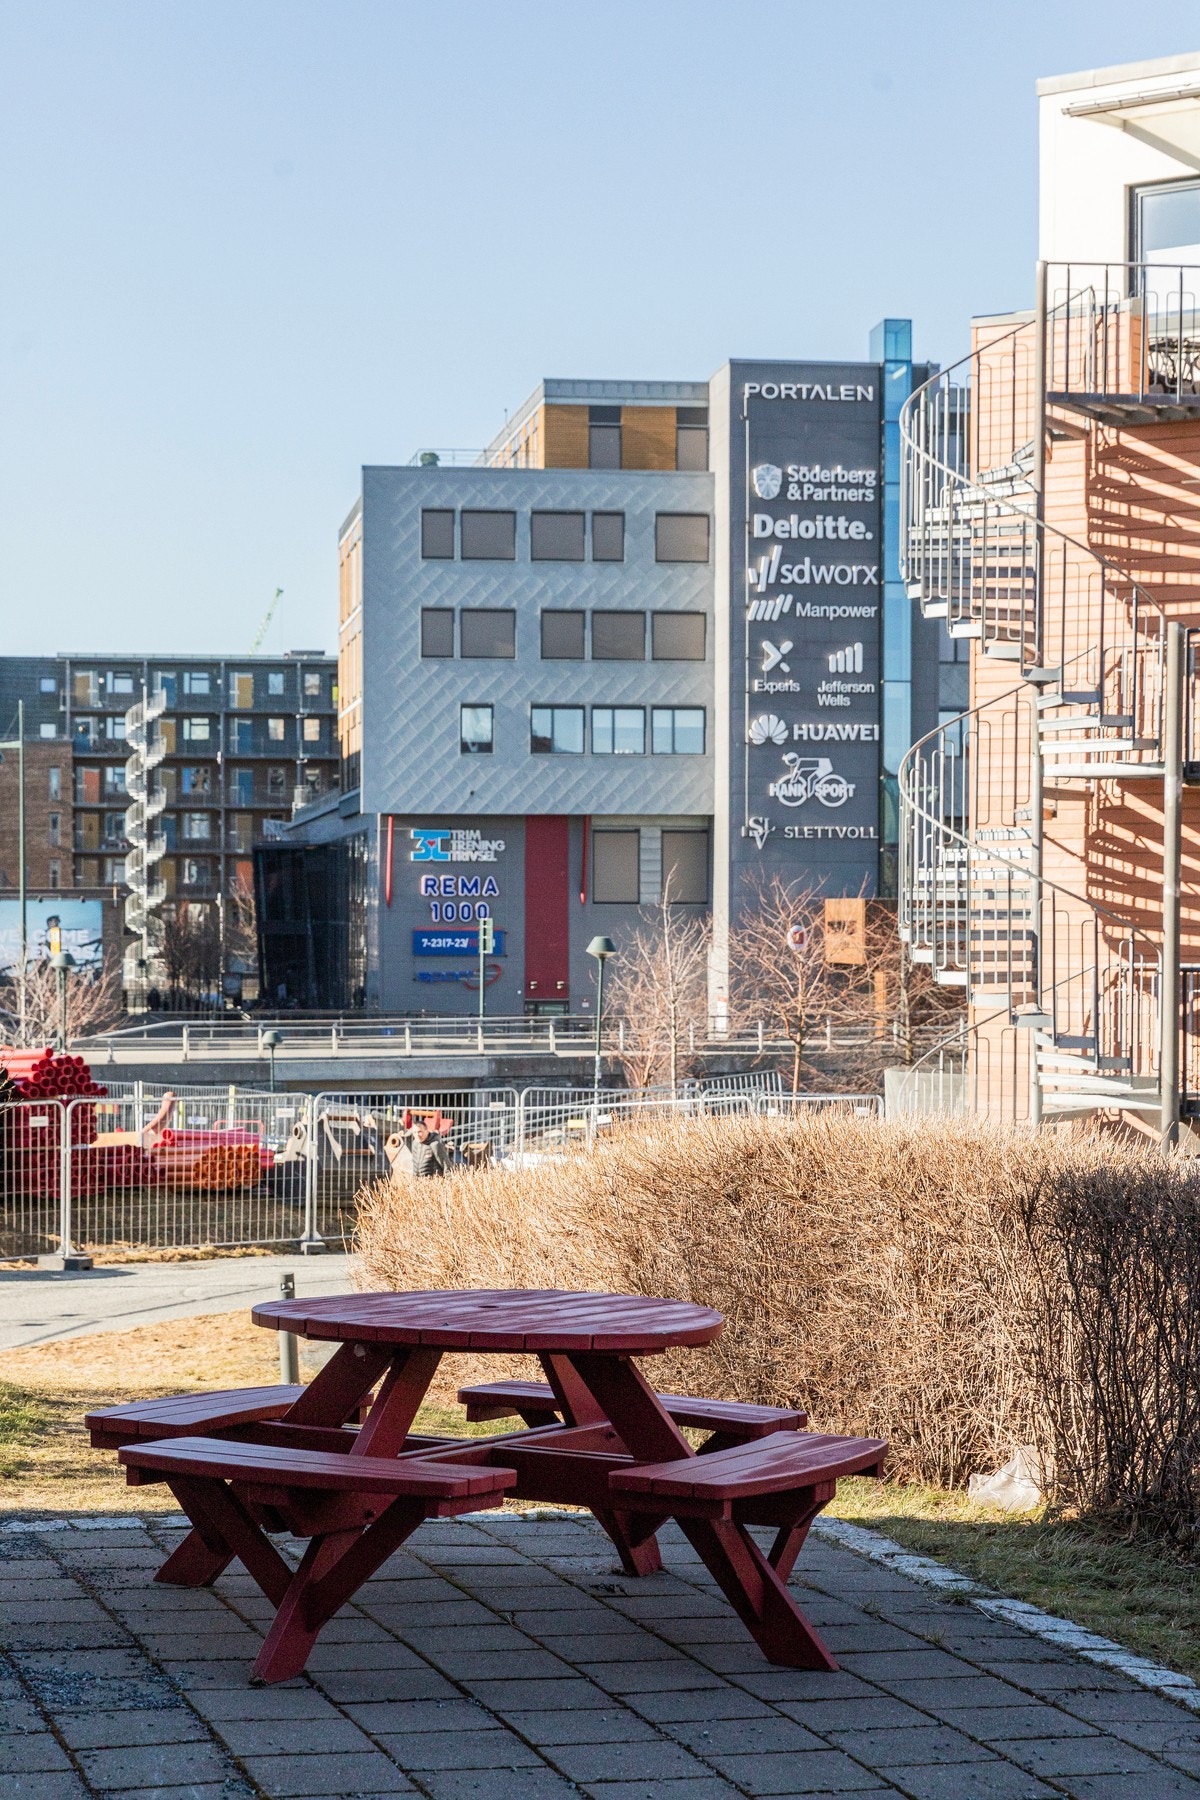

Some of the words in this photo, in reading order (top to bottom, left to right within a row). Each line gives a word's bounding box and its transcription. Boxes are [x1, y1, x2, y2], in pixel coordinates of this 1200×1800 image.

[744, 382, 874, 402] PORTALEN
[787, 464, 877, 487] Söderberg
[803, 484, 875, 502] Partners
[753, 513, 874, 540] Deloitte.
[780, 557, 878, 585] sdworx
[795, 602, 877, 621] Manpower
[754, 679, 800, 694] Experis
[817, 681, 875, 694] Jefferson
[817, 694, 851, 706] Wells
[793, 724, 879, 741] HUAWEI
[815, 783, 856, 798] SPORT
[451, 830, 481, 840] TRIM
[784, 826, 879, 839] SLETTVOLL
[451, 840, 505, 851] TRENING
[450, 851, 497, 861] TRIVSEL
[421, 875, 500, 897] REMA
[431, 901, 490, 923] 1000
